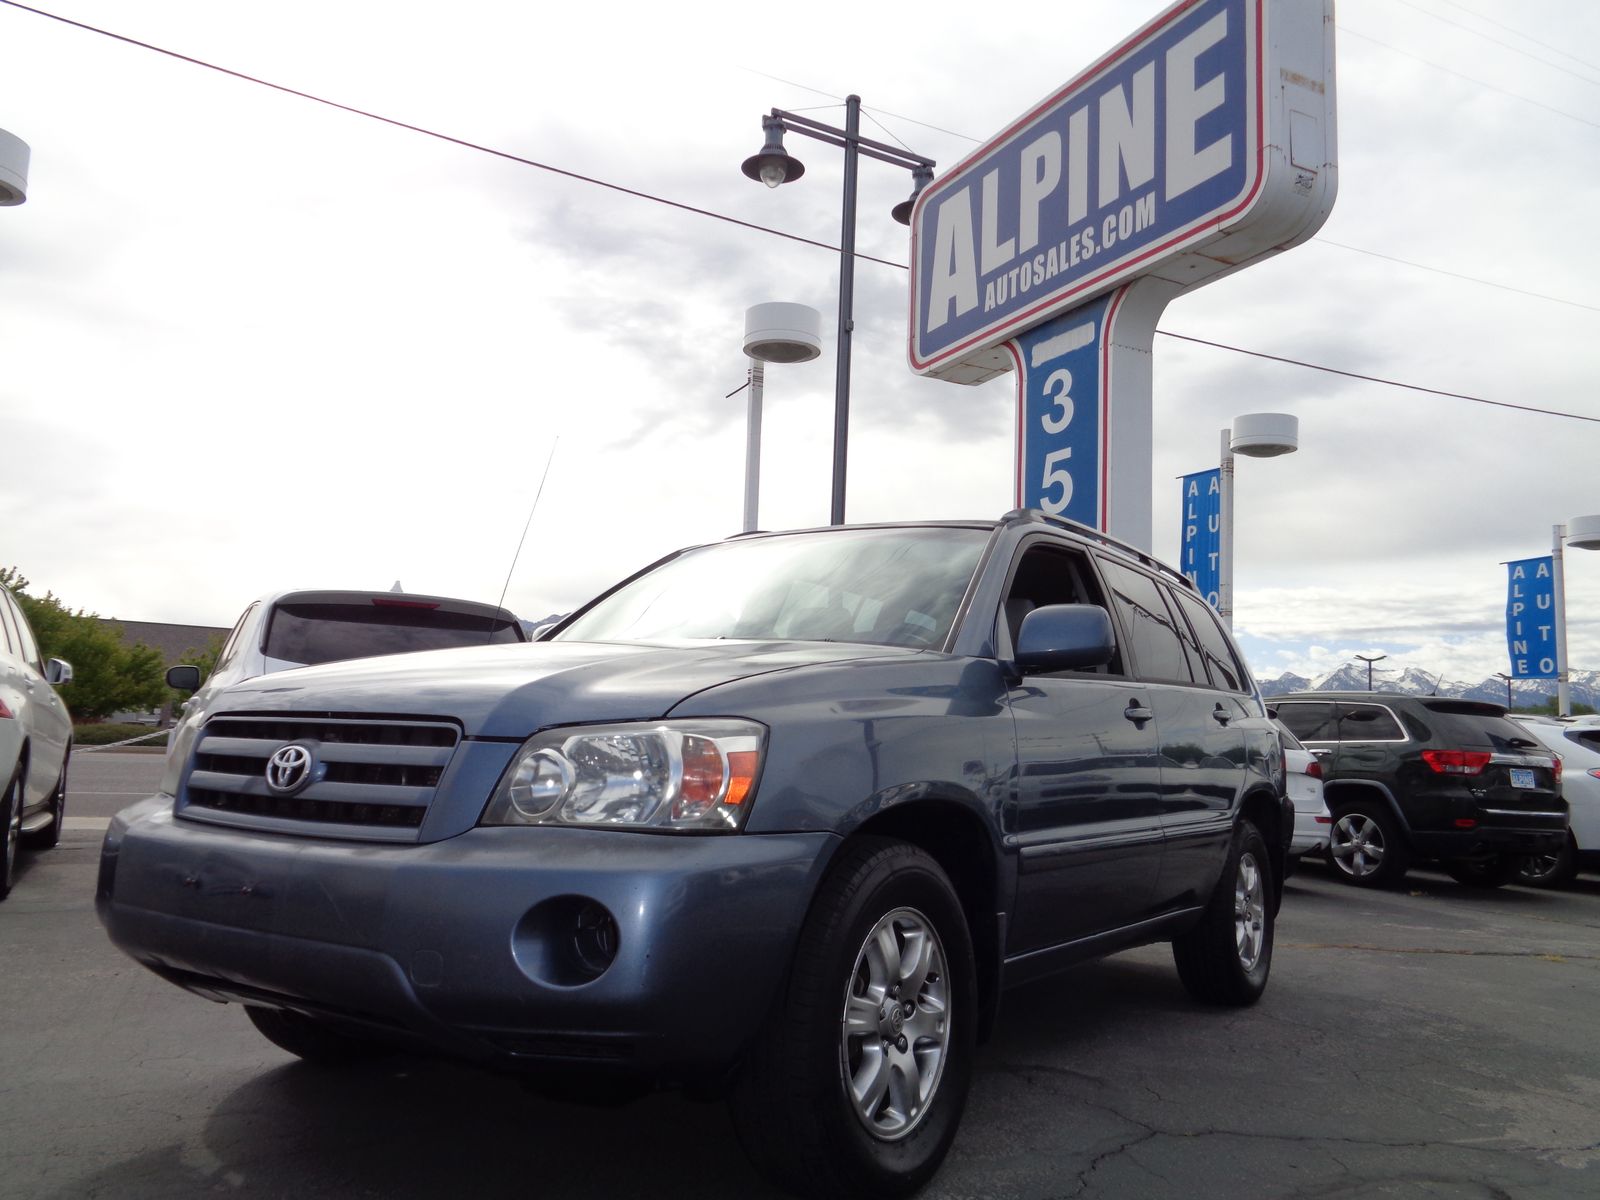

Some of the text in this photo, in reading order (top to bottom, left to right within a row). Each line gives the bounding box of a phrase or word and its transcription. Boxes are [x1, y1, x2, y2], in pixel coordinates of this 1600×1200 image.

[927, 8, 1232, 333] ALPINE
[984, 191, 1156, 312] AUTOSALES.COM
[1186, 480, 1199, 586] ALPIN
[1207, 476, 1220, 609] AUTO
[1512, 565, 1528, 674] ALPINE
[1536, 562, 1554, 674] AUTO
